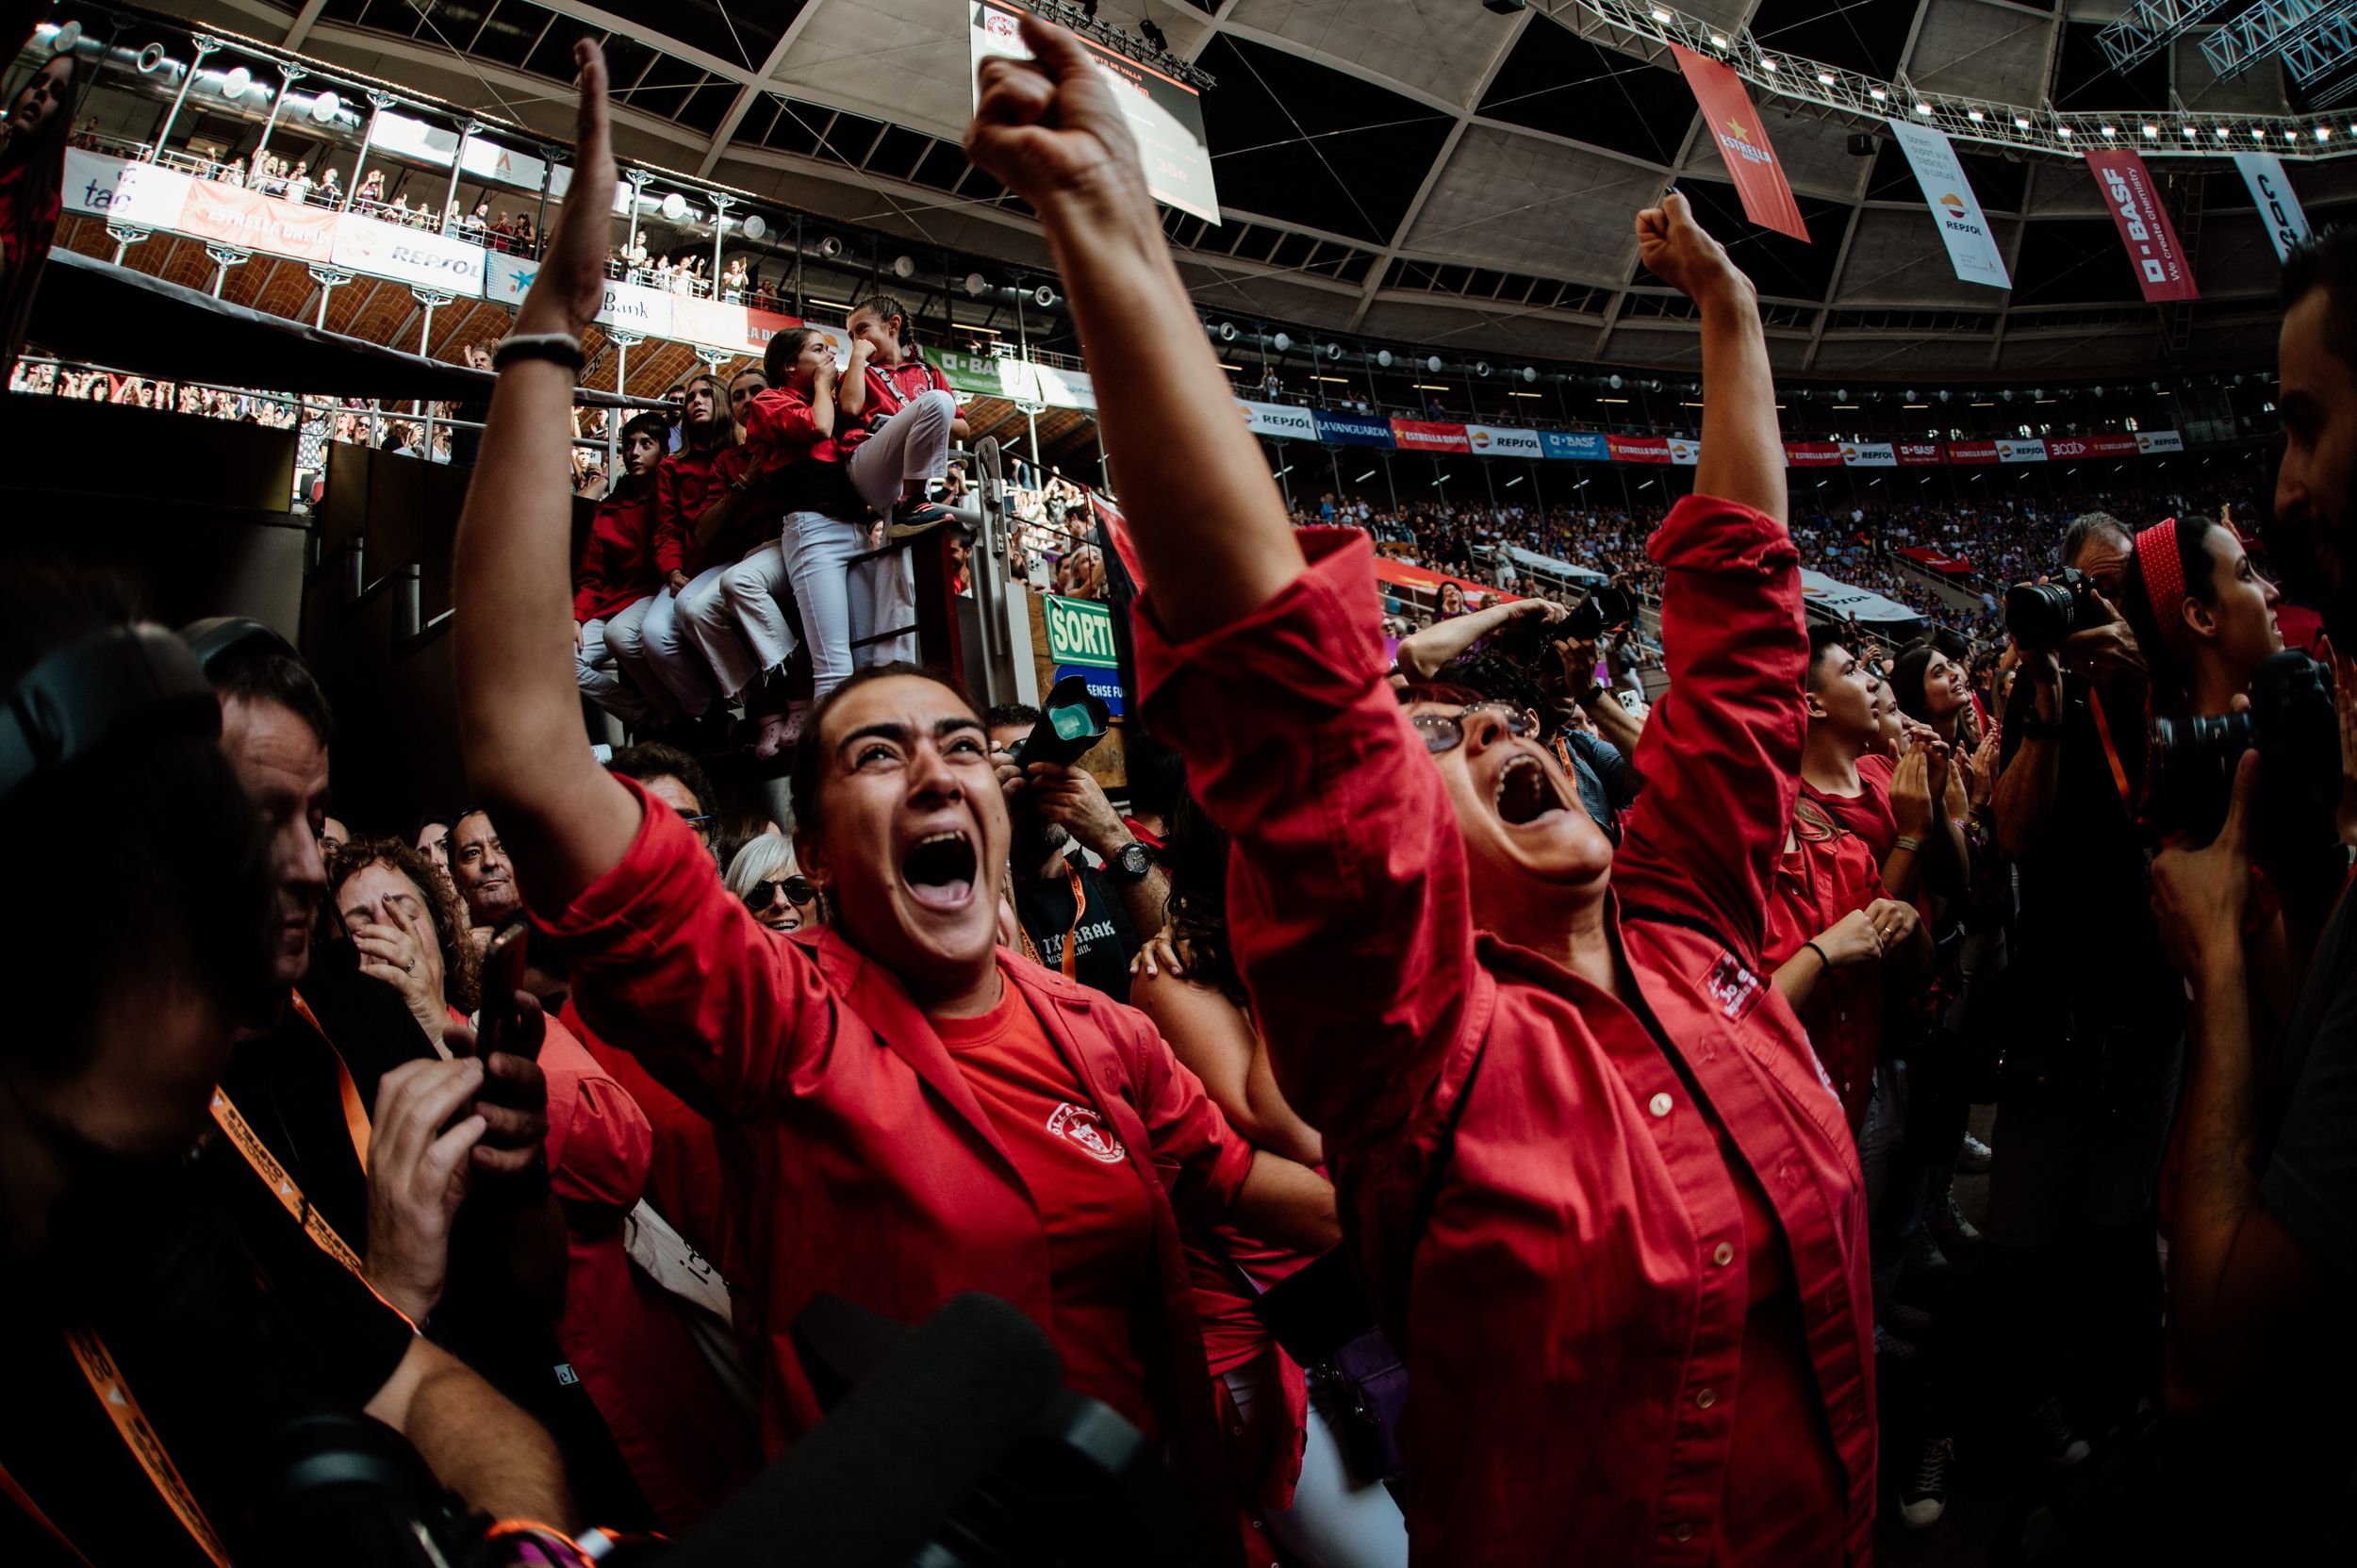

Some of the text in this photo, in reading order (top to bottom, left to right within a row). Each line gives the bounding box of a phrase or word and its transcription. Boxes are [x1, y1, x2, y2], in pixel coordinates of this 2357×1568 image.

[1110, 61, 1120, 72] DE
[1120, 67, 1143, 81] VALLS
[1720, 133, 1772, 164] ESTRELLA
[2102, 168, 2151, 241] BASF
[1945, 220, 1983, 236] REPSOL
[2127, 167, 2181, 282] We create chemistry
[390, 245, 481, 279] REPSOL
[1263, 414, 1311, 429] REPSOL
[1318, 421, 1390, 438] LA VANGUARDIA
[1406, 431, 1467, 445] ESTRELLA DAMM
[1497, 437, 1539, 449] REPSOL
[1566, 436, 1596, 448] BASF
[1619, 444, 1649, 454] ESTRELLA
[1861, 451, 1894, 460] REPSOL
[1915, 445, 1936, 455] BASF
[2016, 446, 2044, 454] REPSOL
[1051, 607, 1116, 657] SORTI
[1086, 684, 1112, 697] SENSE
[227, 1119, 279, 1184] CONCURS
[228, 1108, 284, 1179] CASTELLS
